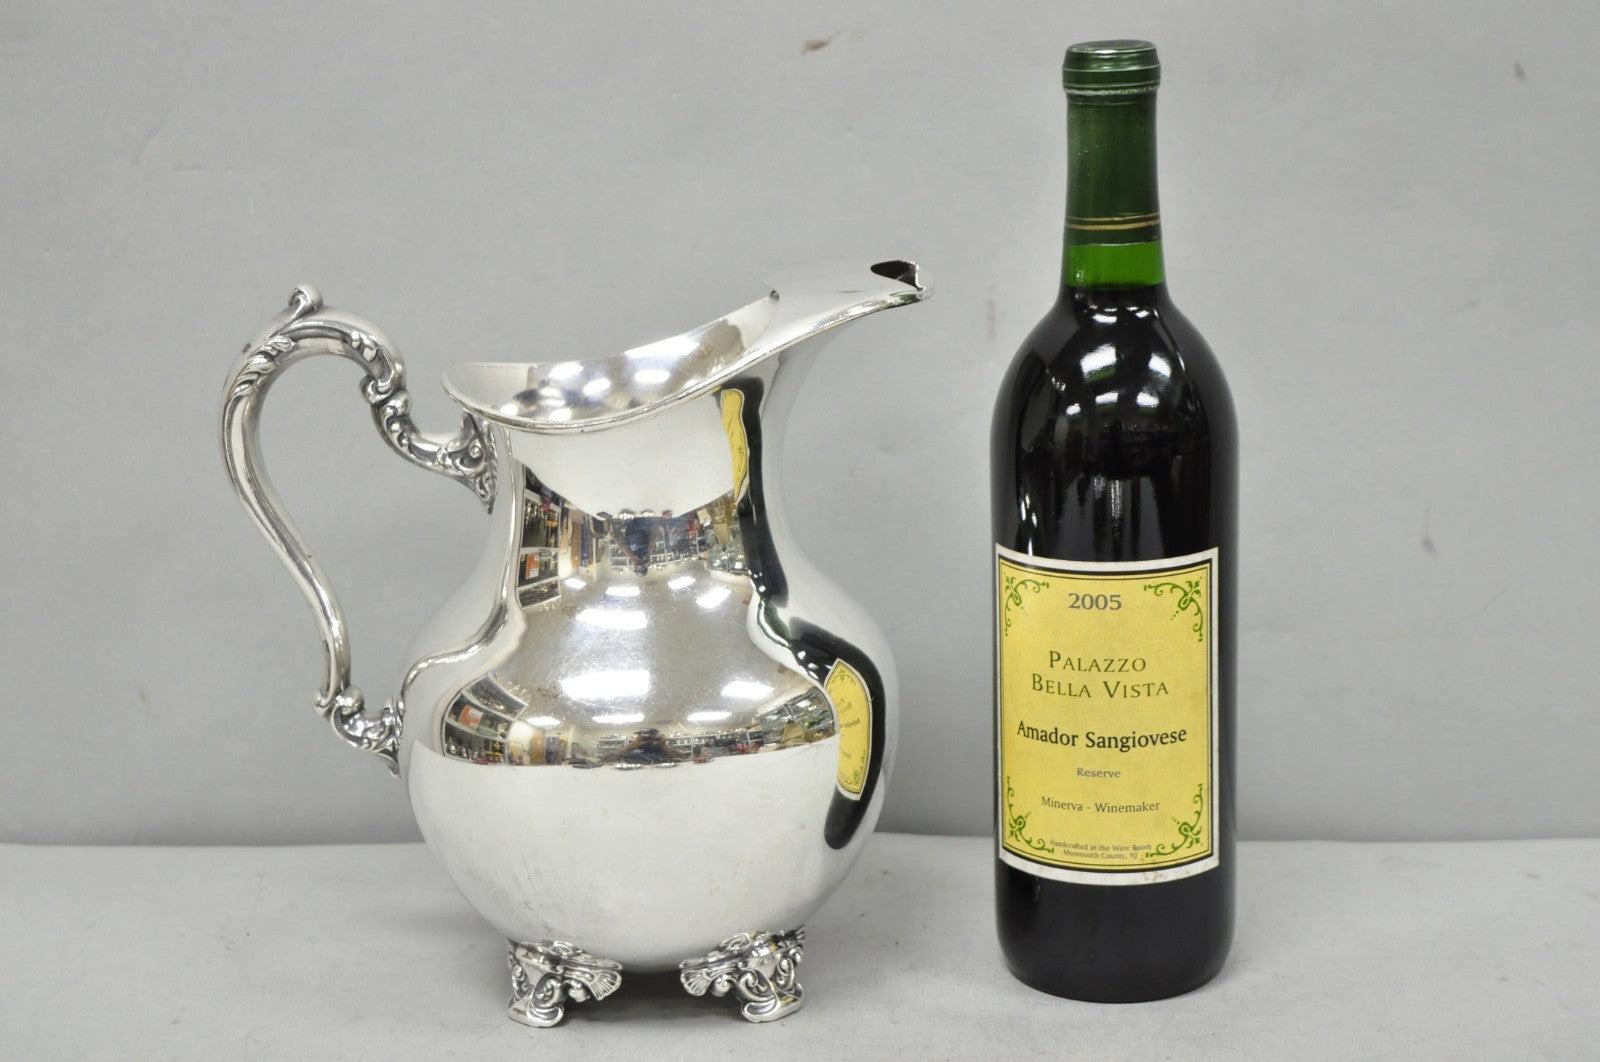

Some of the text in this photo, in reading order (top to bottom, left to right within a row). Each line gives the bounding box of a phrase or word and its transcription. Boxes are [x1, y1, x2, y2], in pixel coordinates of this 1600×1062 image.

[1068, 593, 1122, 611] 2005
[1049, 650, 1147, 673] PALAZZO
[1032, 673, 1169, 699] BELLA VISTA
[1017, 720, 1188, 752] Amador Sangiovese
[1076, 767, 1121, 778] Reserve
[1041, 796, 1083, 812] Minerva
[1095, 802, 1161, 813] Winemaker
[1049, 839, 1089, 850] Handcrafted
[1098, 844, 1110, 852] the
[1063, 849, 1100, 859] Monmouth
[1129, 852, 1138, 860] NJ
